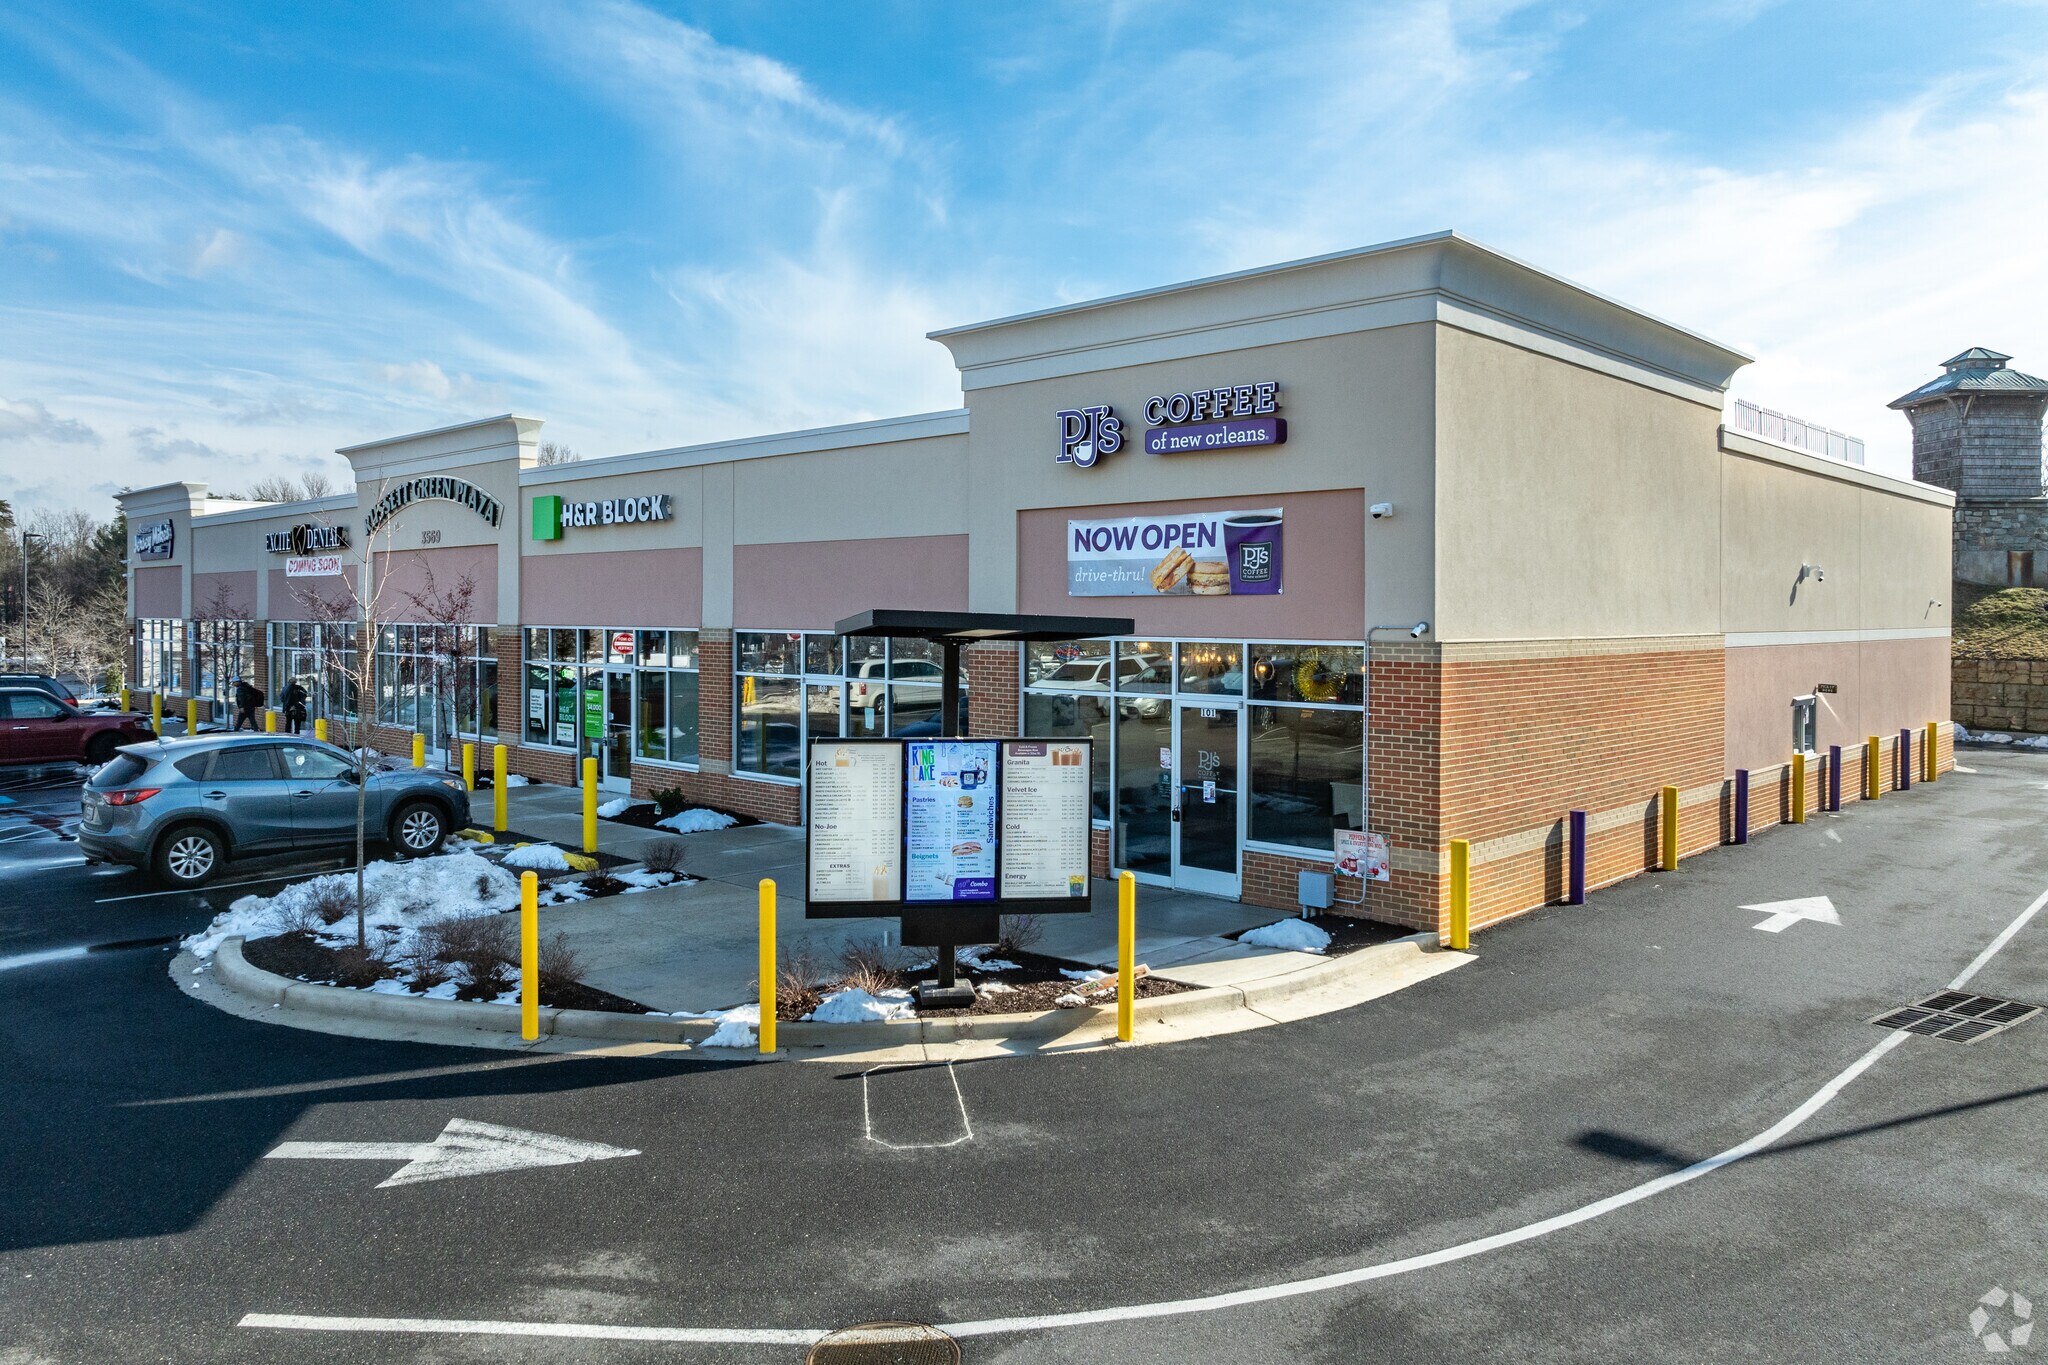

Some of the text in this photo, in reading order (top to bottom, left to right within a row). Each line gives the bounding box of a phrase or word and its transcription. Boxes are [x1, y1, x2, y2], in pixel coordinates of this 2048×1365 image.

[1143, 381, 1277, 426] COFFEE
[1055, 405, 1122, 468] PJ's
[1151, 432, 1167, 450] of
[1170, 434, 1202, 449] new
[412, 477, 453, 500] GREEN
[455, 482, 497, 525] PLAZA
[562, 494, 664, 528] H&R BLOCK
[265, 526, 340, 552] EXCITE DENTAL
[1074, 521, 1217, 553] NOW OPEN
[288, 557, 340, 573] COMING SOON
[1242, 546, 1269, 569] PJ's
[1075, 565, 1146, 582] drive-thru!
[1242, 568, 1268, 576] COFFEE
[1202, 709, 1216, 717] 101
[912, 750, 934, 766] KING
[1198, 750, 1220, 771] PJ's
[912, 765, 936, 782] CAKE
